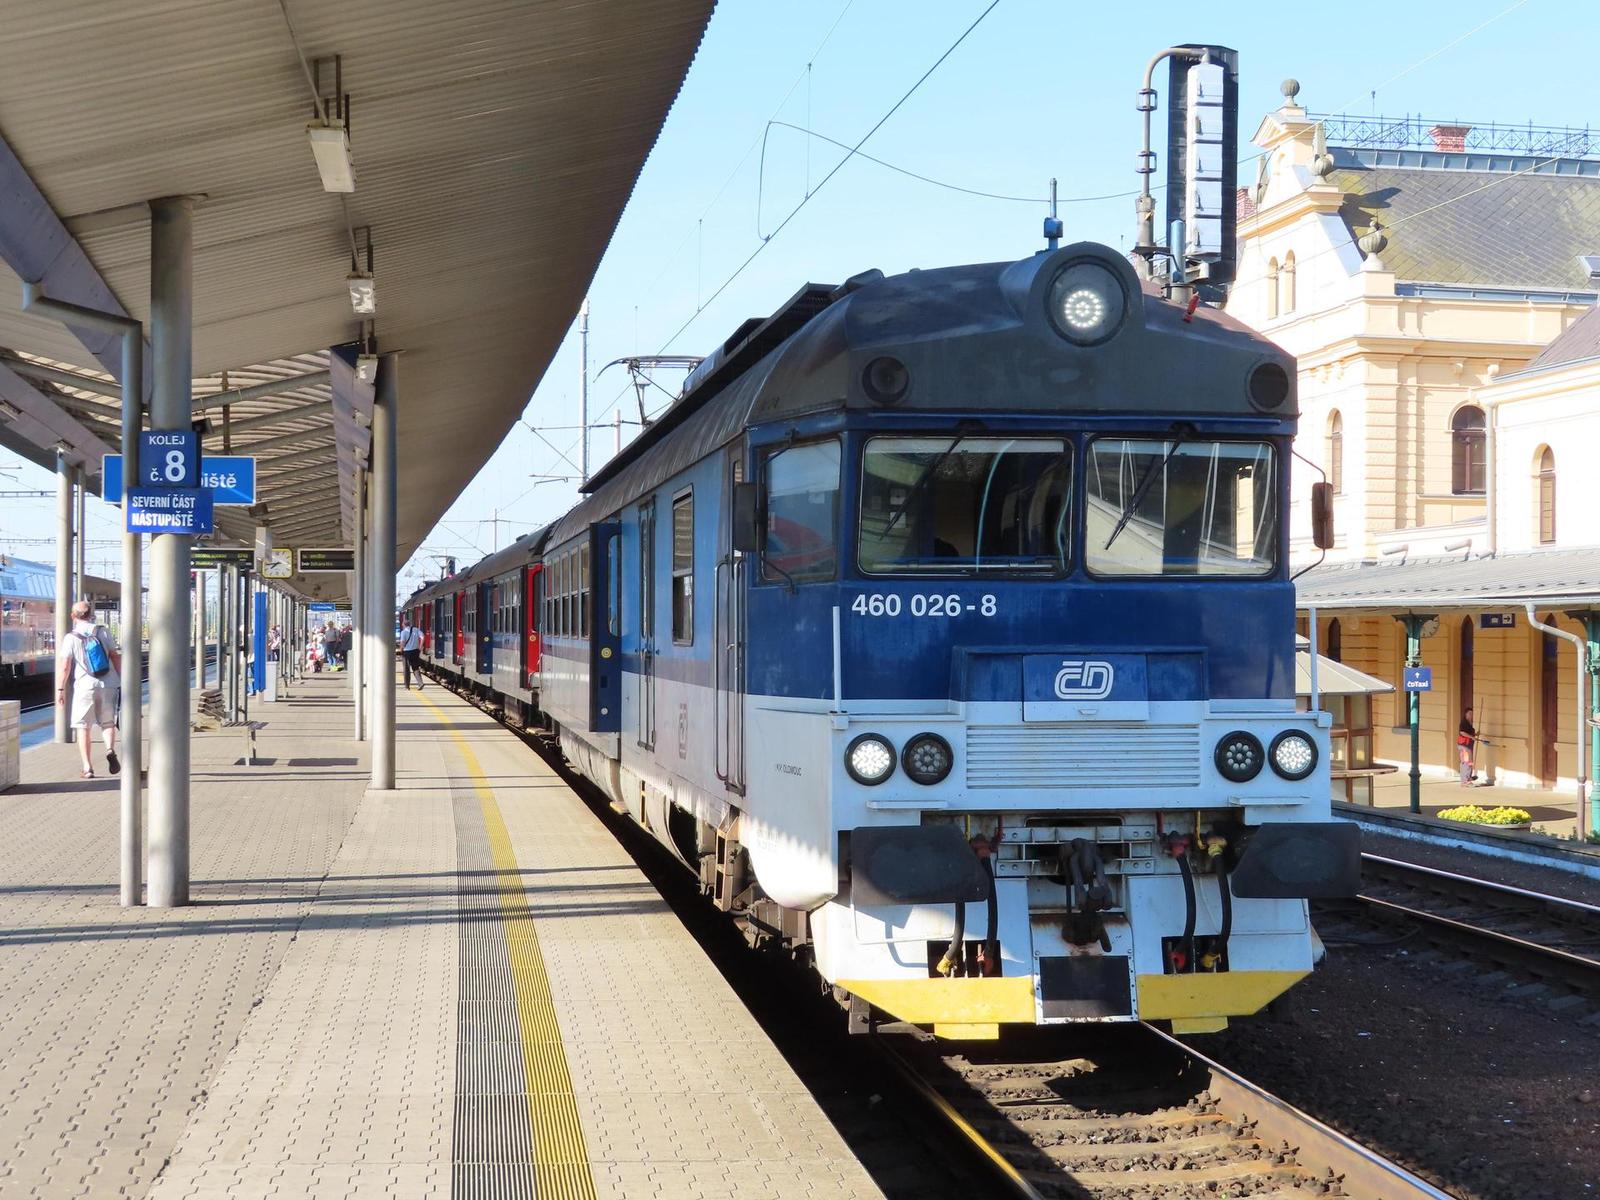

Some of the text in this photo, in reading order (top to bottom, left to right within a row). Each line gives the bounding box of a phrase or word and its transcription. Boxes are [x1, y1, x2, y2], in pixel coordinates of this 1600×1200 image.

[149, 435, 184, 445] KOLEJ
[150, 450, 186, 482] č. 8
[132, 494, 196, 509] SEVERNÍ ČÁST
[131, 510, 194, 527] NÁSTUPIŠTĚ
[851, 593, 997, 617] 460 026-8
[1054, 660, 1114, 700] ČD
